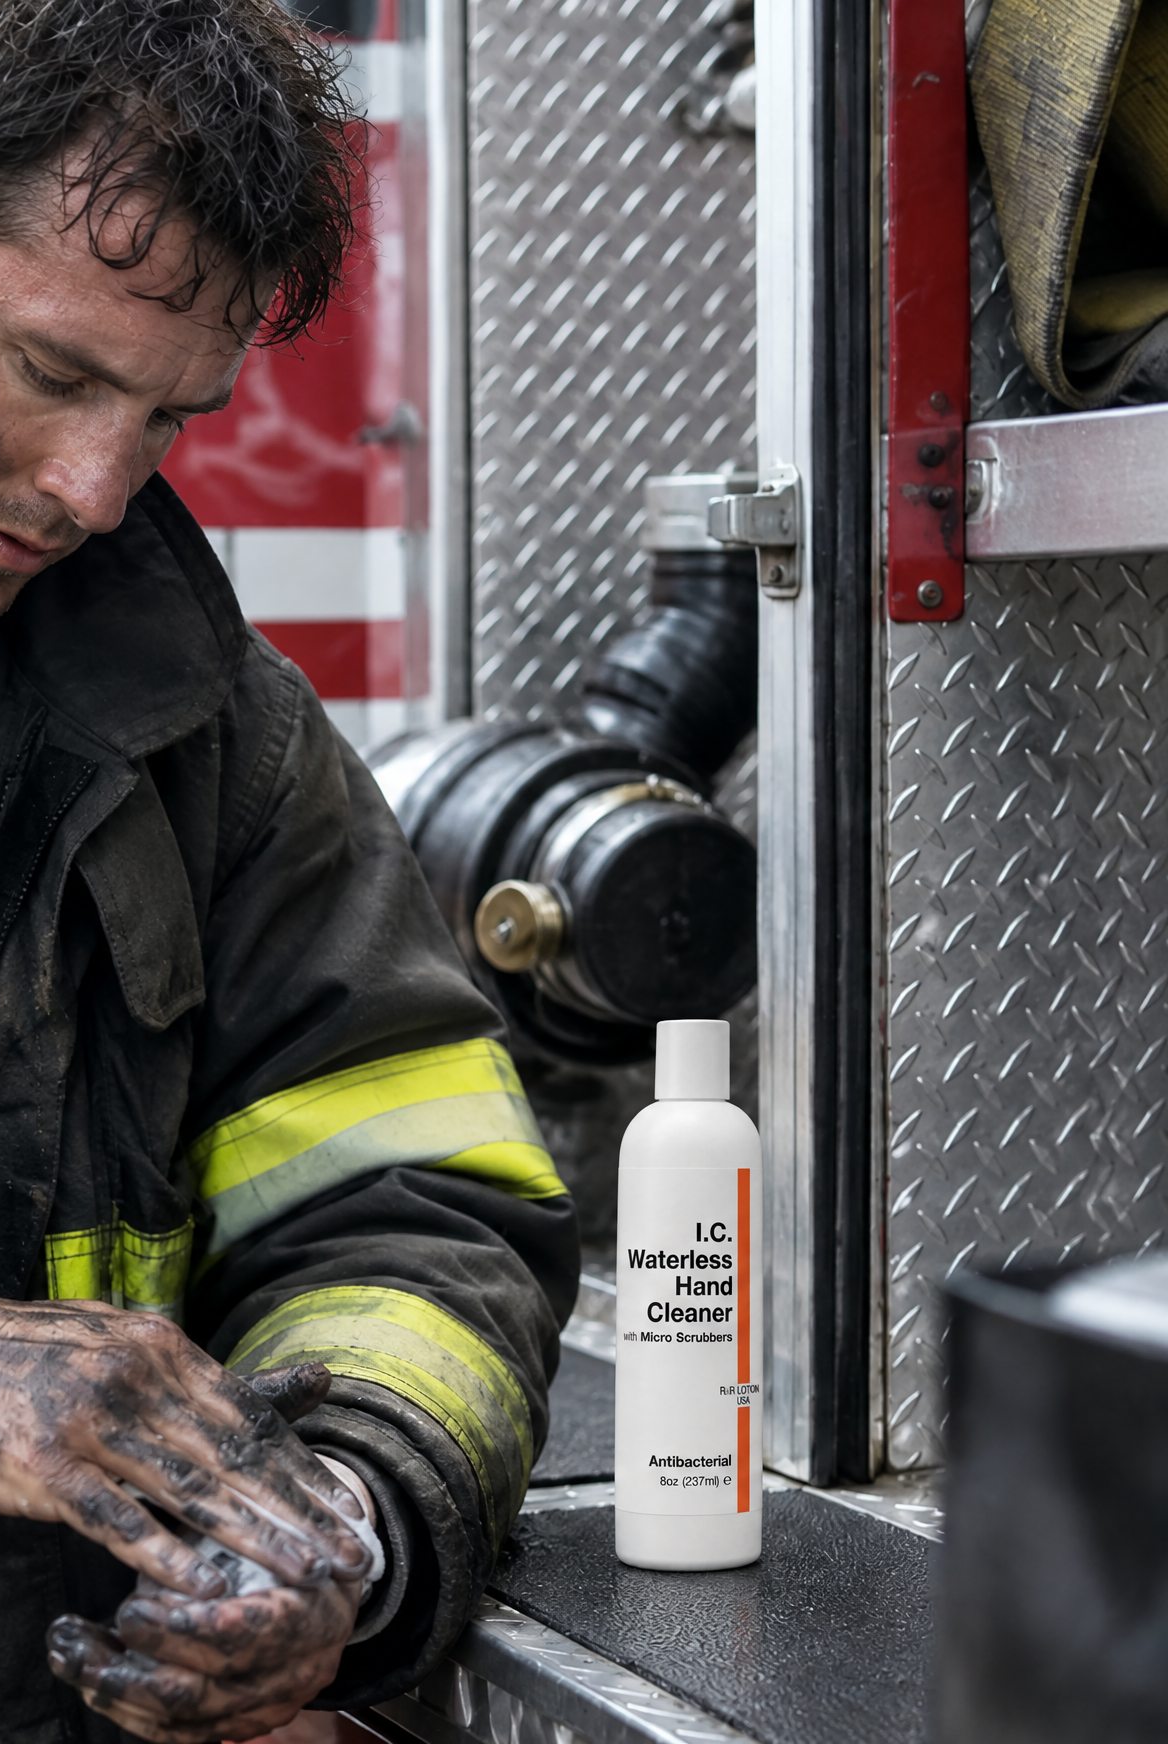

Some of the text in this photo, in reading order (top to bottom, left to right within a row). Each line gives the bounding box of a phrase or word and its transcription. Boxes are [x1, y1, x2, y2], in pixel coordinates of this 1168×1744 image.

[696, 1222, 733, 1243] I.C.
[628, 1249, 733, 1270] Waterless
[675, 1276, 733, 1296] Hand
[647, 1302, 733, 1323] Cleaner
[623, 1332, 733, 1343] with Micro Scrubbers
[736, 1396, 751, 1405] USA
[649, 1454, 732, 1468] Antibacterial
[660, 1476, 679, 1487] 8oz
[682, 1476, 720, 1489] (237ml)
